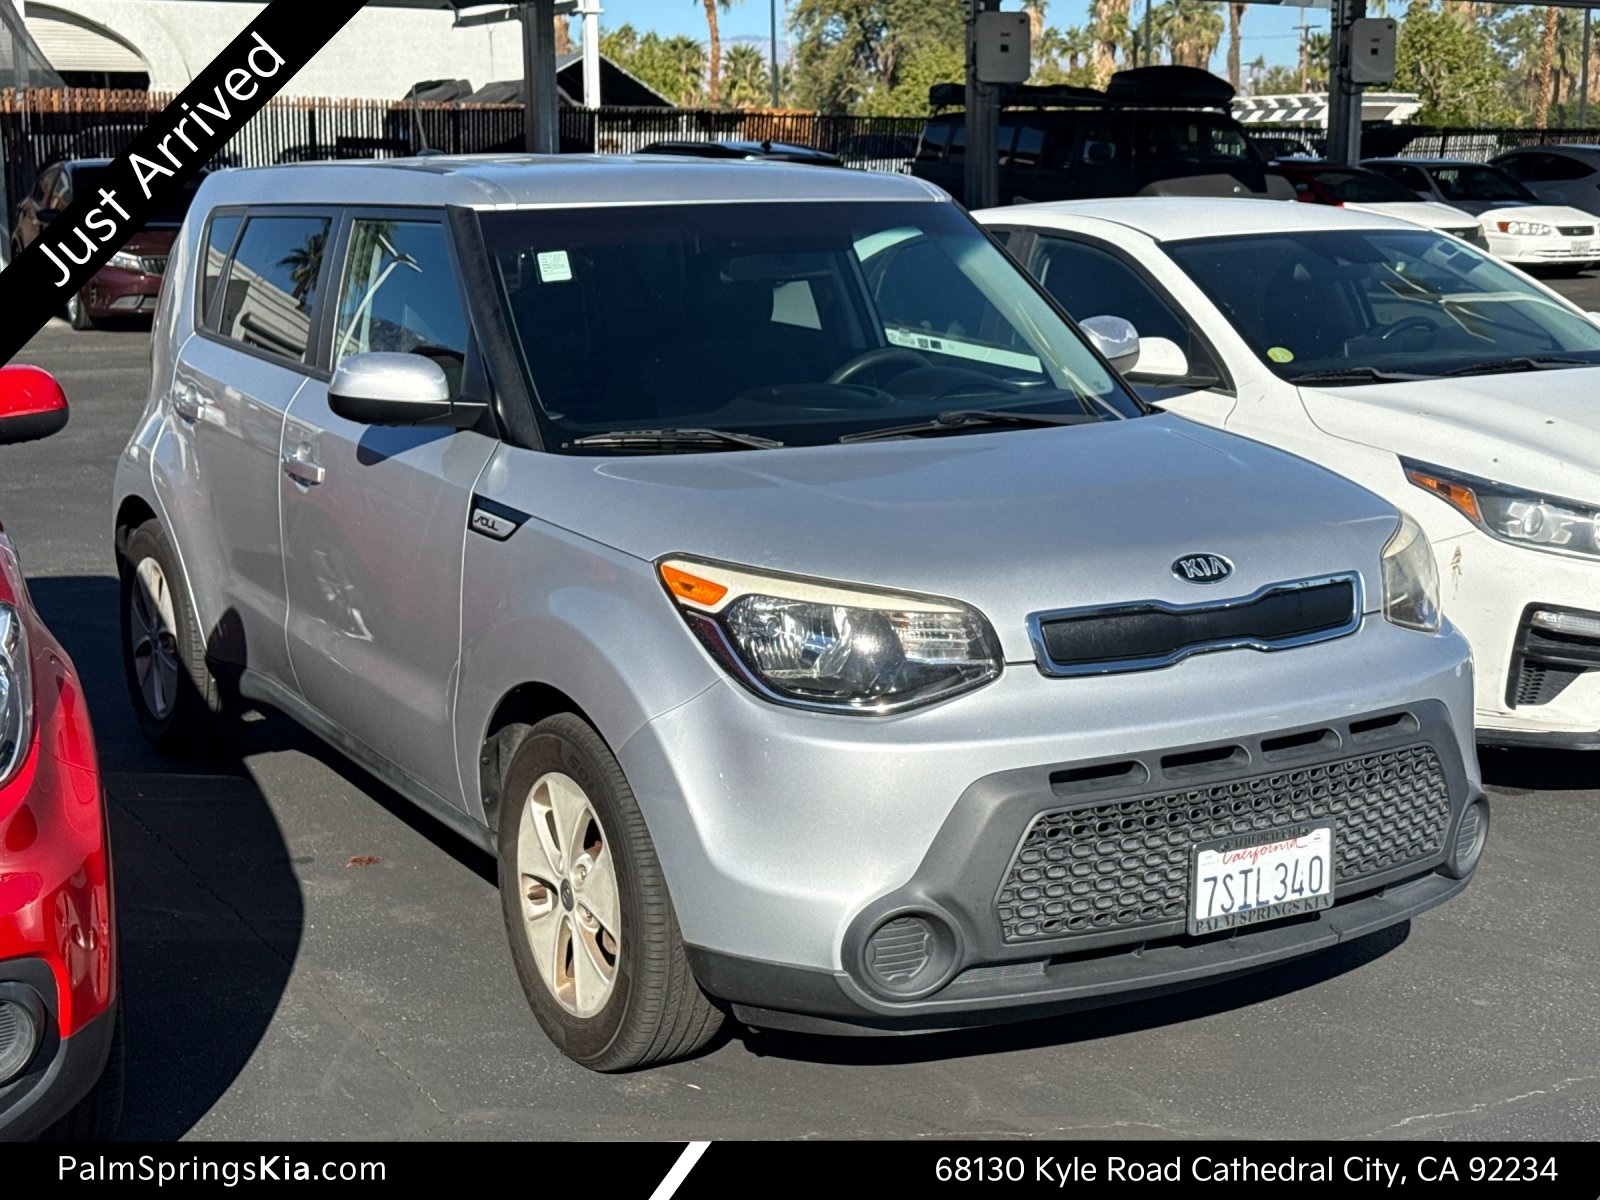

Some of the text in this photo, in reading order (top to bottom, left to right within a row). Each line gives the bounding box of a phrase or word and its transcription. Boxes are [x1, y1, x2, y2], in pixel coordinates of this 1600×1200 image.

[1179, 556, 1228, 579] KIA
[1203, 855, 1323, 916] 7SIL340
[1195, 895, 1330, 934] PALM SPRINGS KIA
